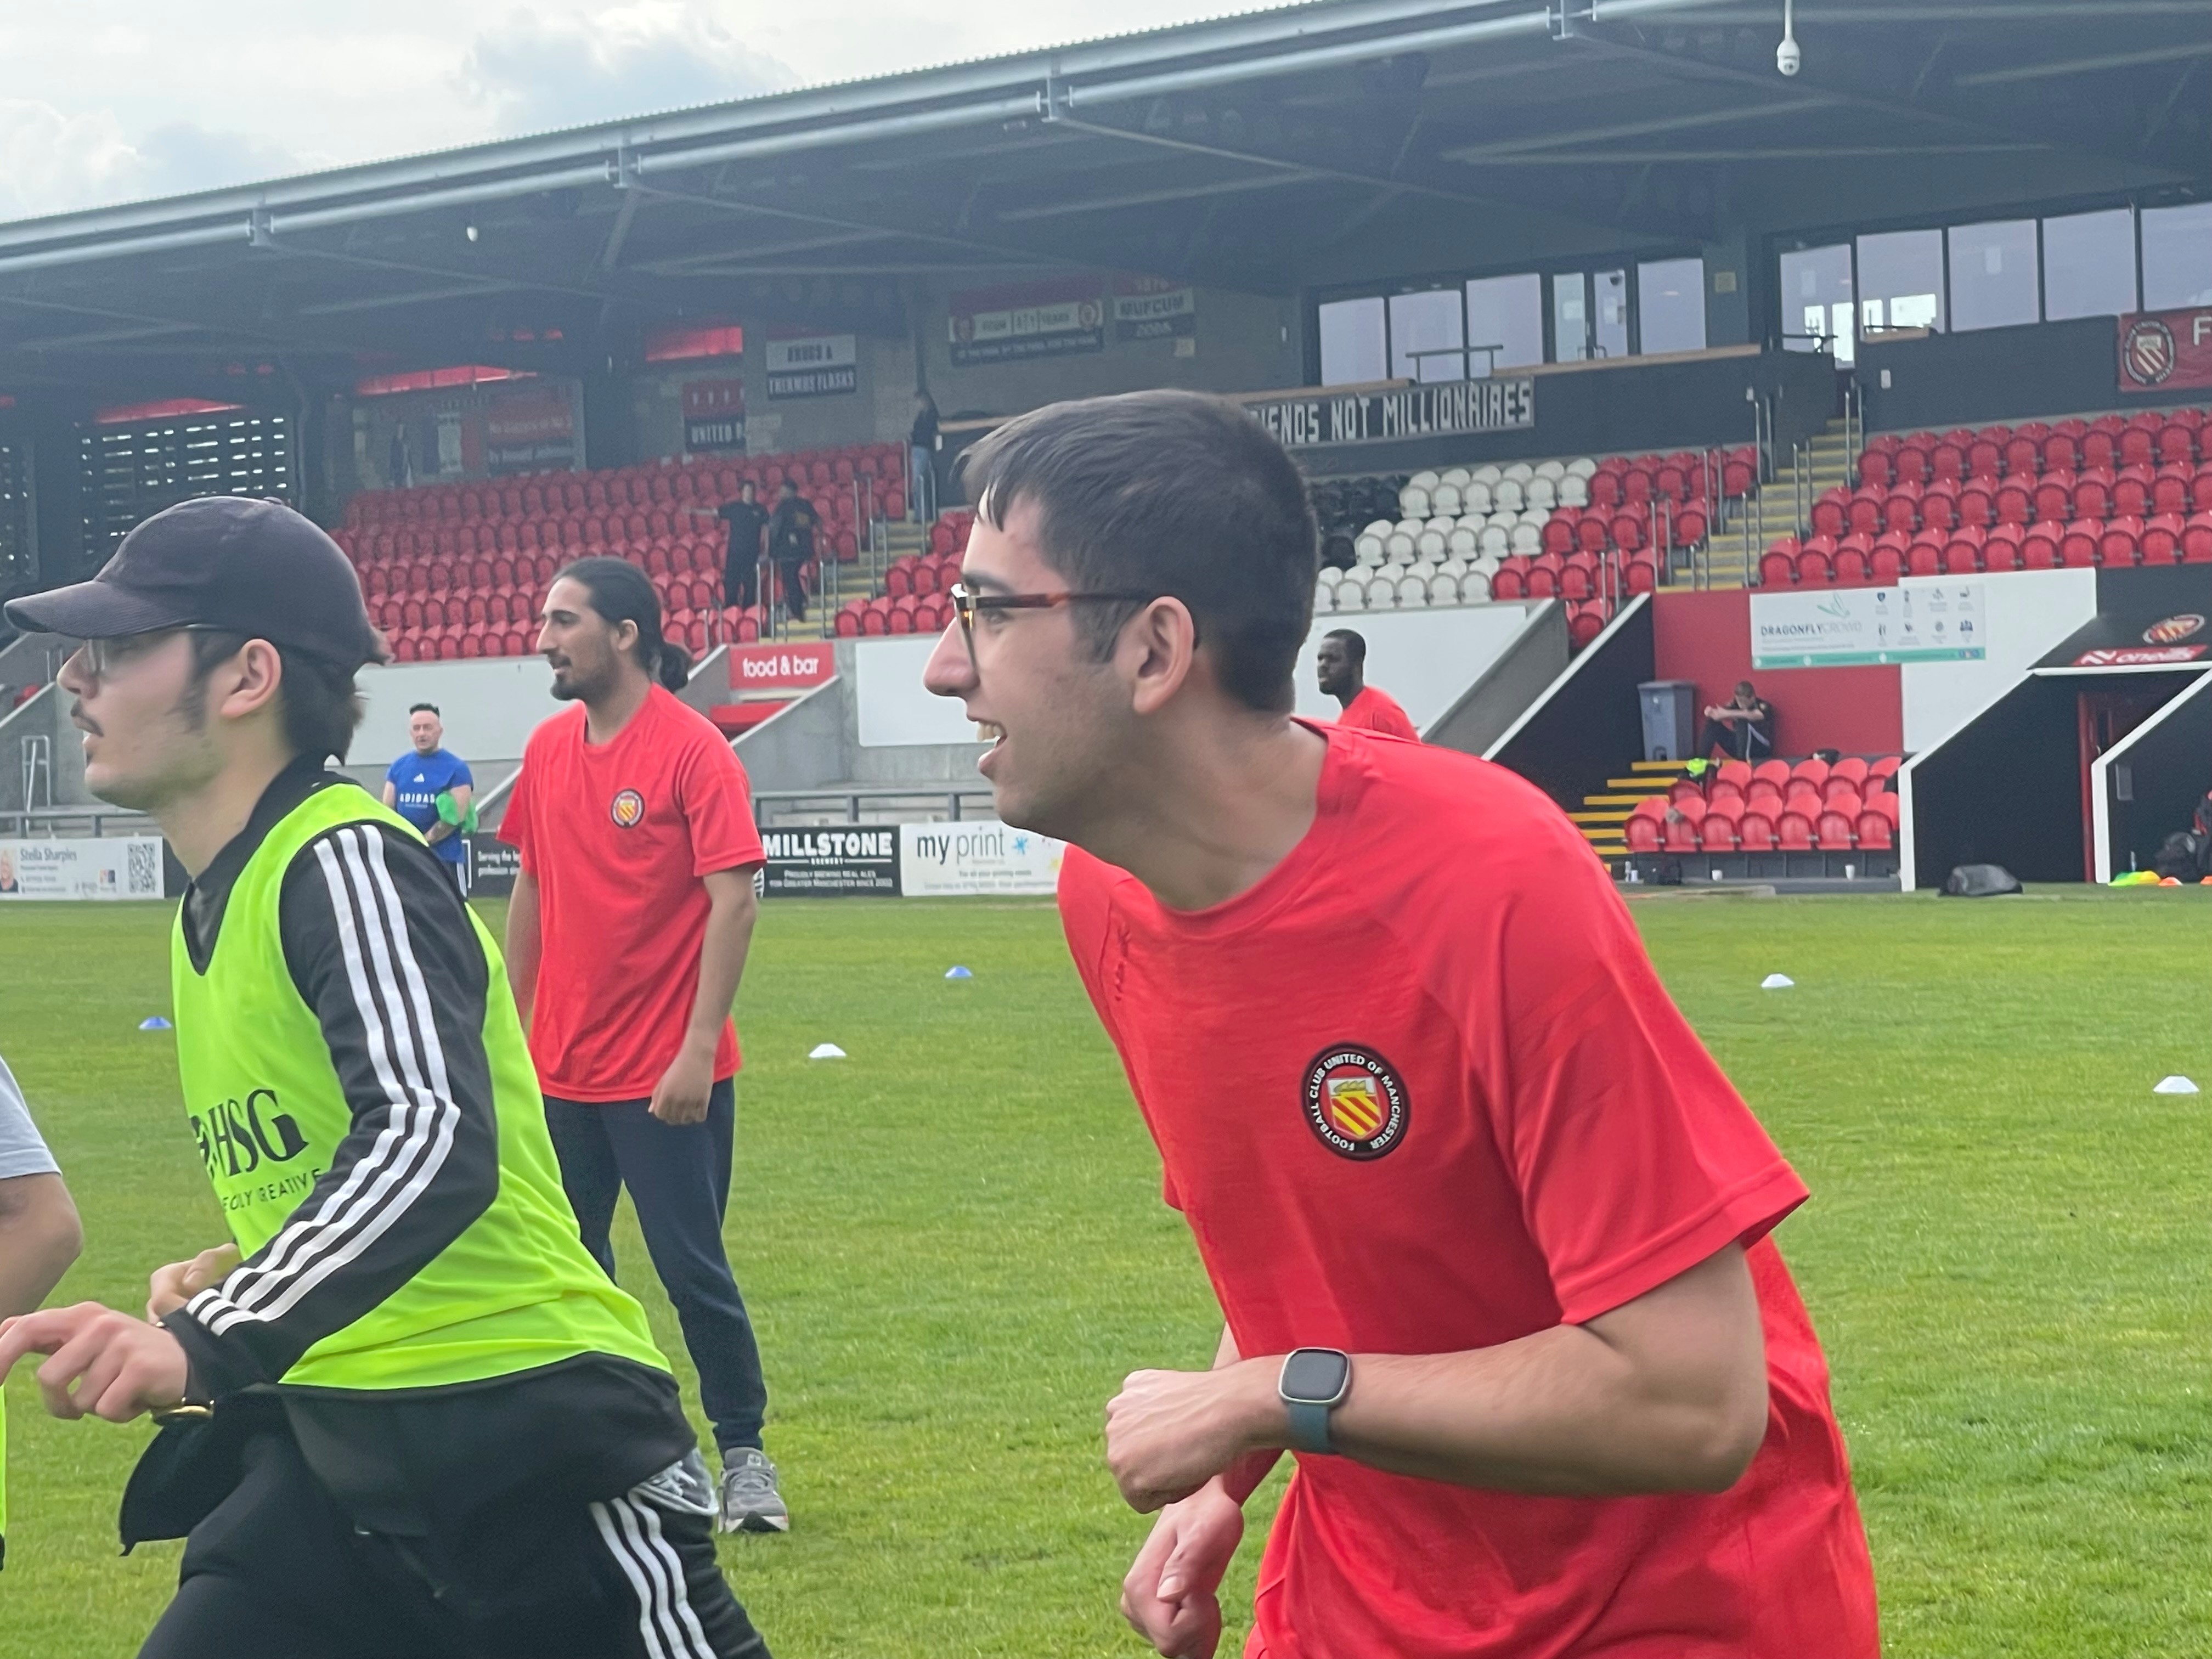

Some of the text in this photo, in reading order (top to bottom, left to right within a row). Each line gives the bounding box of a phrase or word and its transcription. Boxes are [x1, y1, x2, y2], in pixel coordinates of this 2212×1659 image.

[1331, 397, 1370, 441] NOT
[1383, 382, 1531, 438] MILLIONAIRES
[743, 655, 819, 678] food & bar
[762, 832, 894, 857] MILLSTONE
[917, 826, 1005, 865] my print
[1309, 1053, 1401, 1151] FOOTBALL CLUB UNITED OF MANCHESTER
